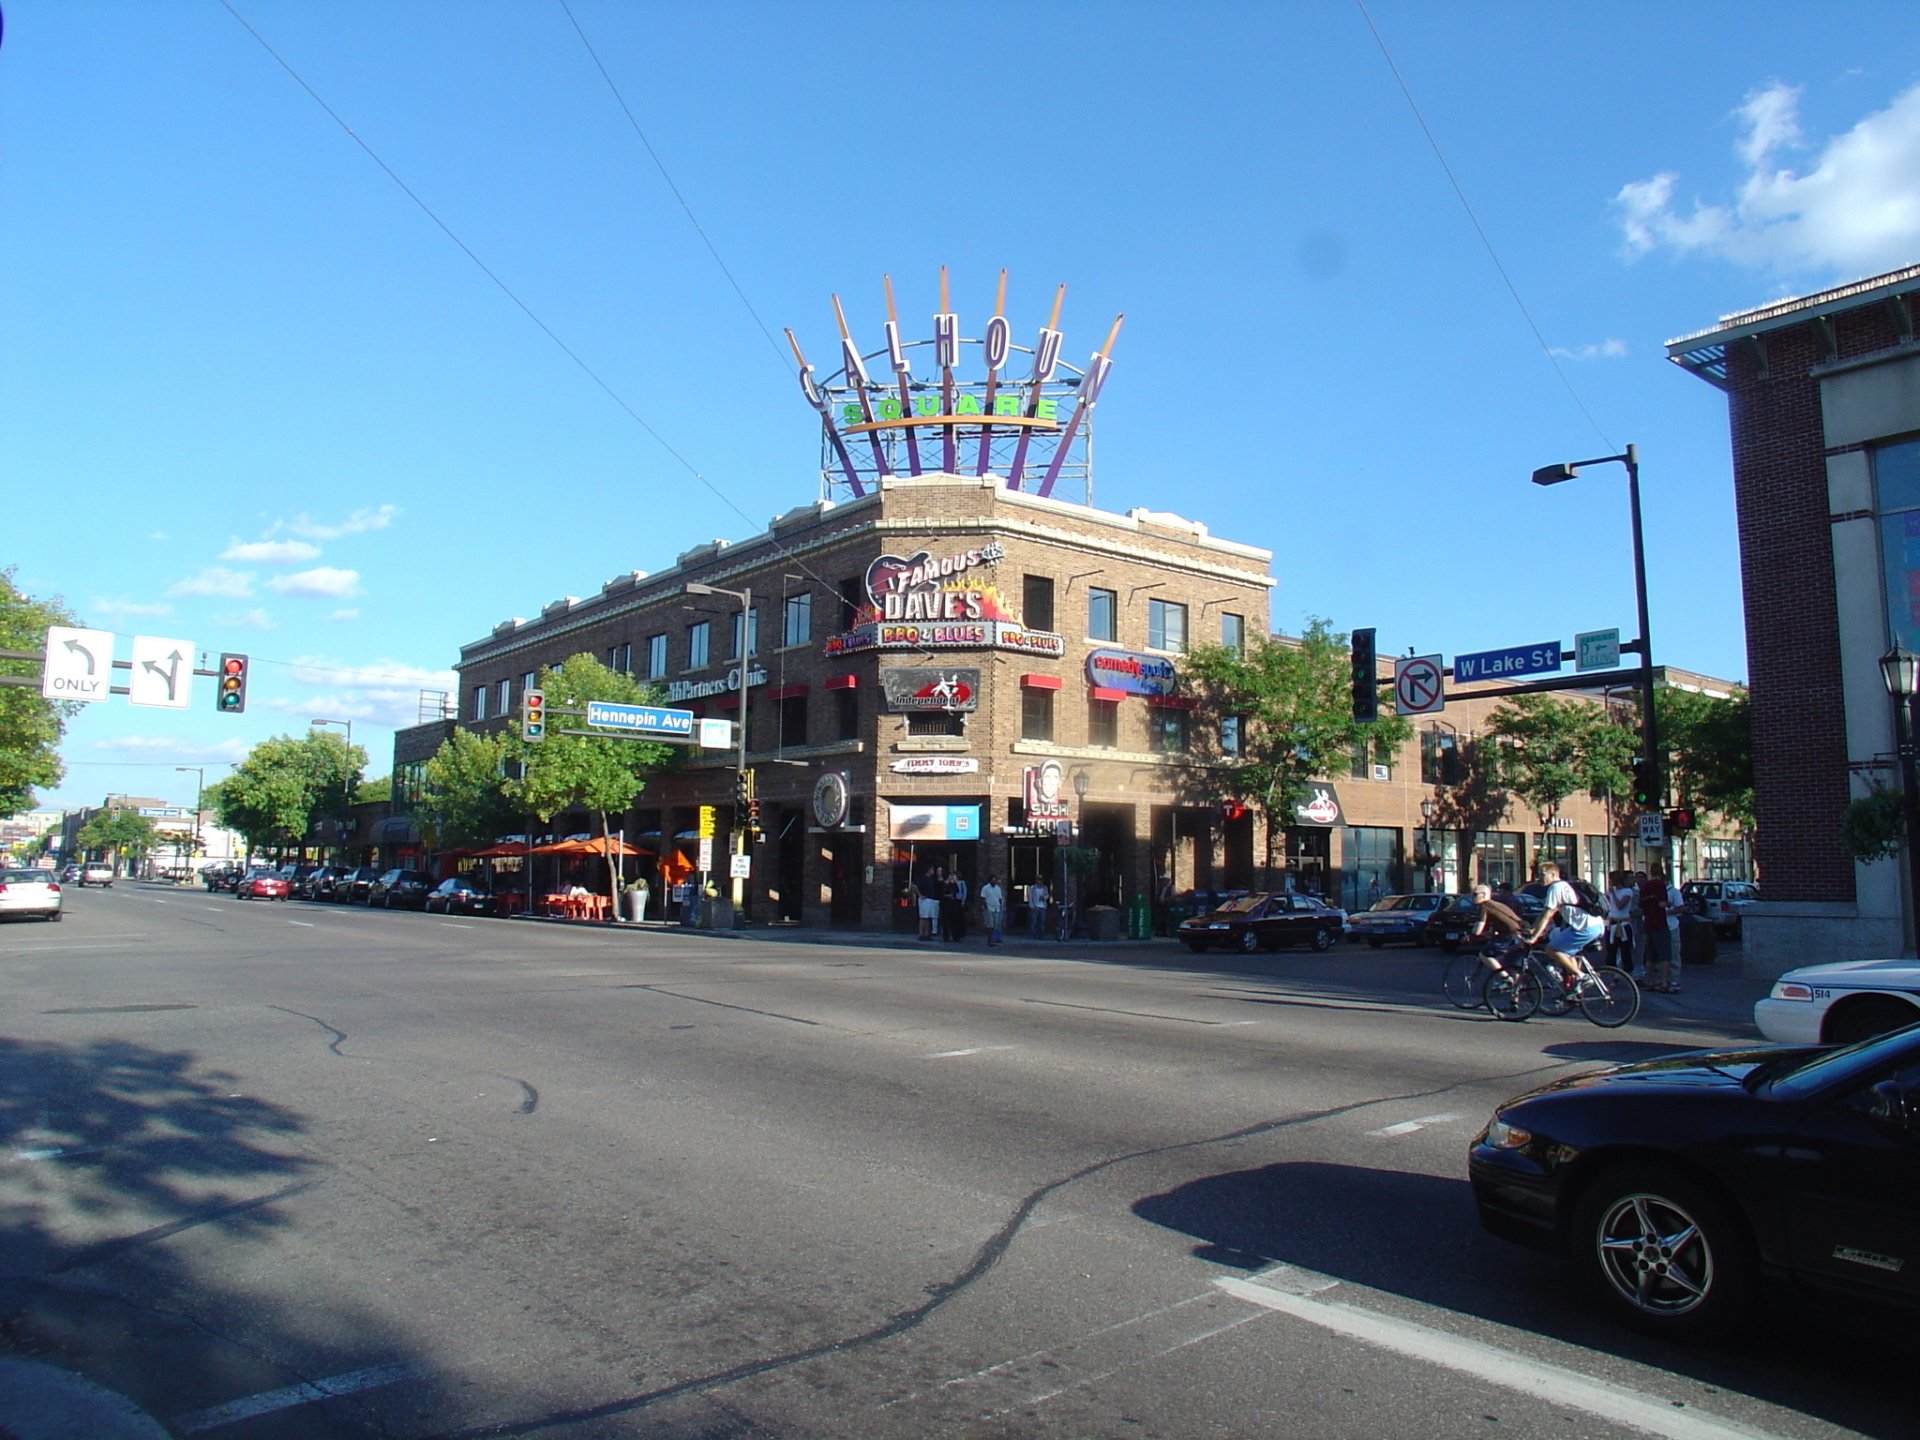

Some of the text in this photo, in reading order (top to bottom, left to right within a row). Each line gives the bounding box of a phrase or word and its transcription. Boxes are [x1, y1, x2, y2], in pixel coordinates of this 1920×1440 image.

[800, 313, 1113, 412] CALHOUN
[843, 395, 1059, 425] SQUARE
[896, 549, 981, 594] FAMOUS
[884, 591, 983, 620] DAVE'S
[882, 626, 918, 643] BBQ
[933, 625, 986, 643] BLUES
[1001, 631, 1023, 645] BBQ
[1030, 632, 1060, 650] BLUES
[1460, 650, 1554, 677] W Lake St
[53, 677, 100, 693] ONLY
[589, 706, 691, 730] Hennepin Ave
[906, 759, 935, 767] JIMMY
[1030, 803, 1069, 816] SUSHI
[1641, 815, 1660, 825] ONE
[1641, 824, 1661, 836] WAY
[1815, 989, 1831, 999] 514
